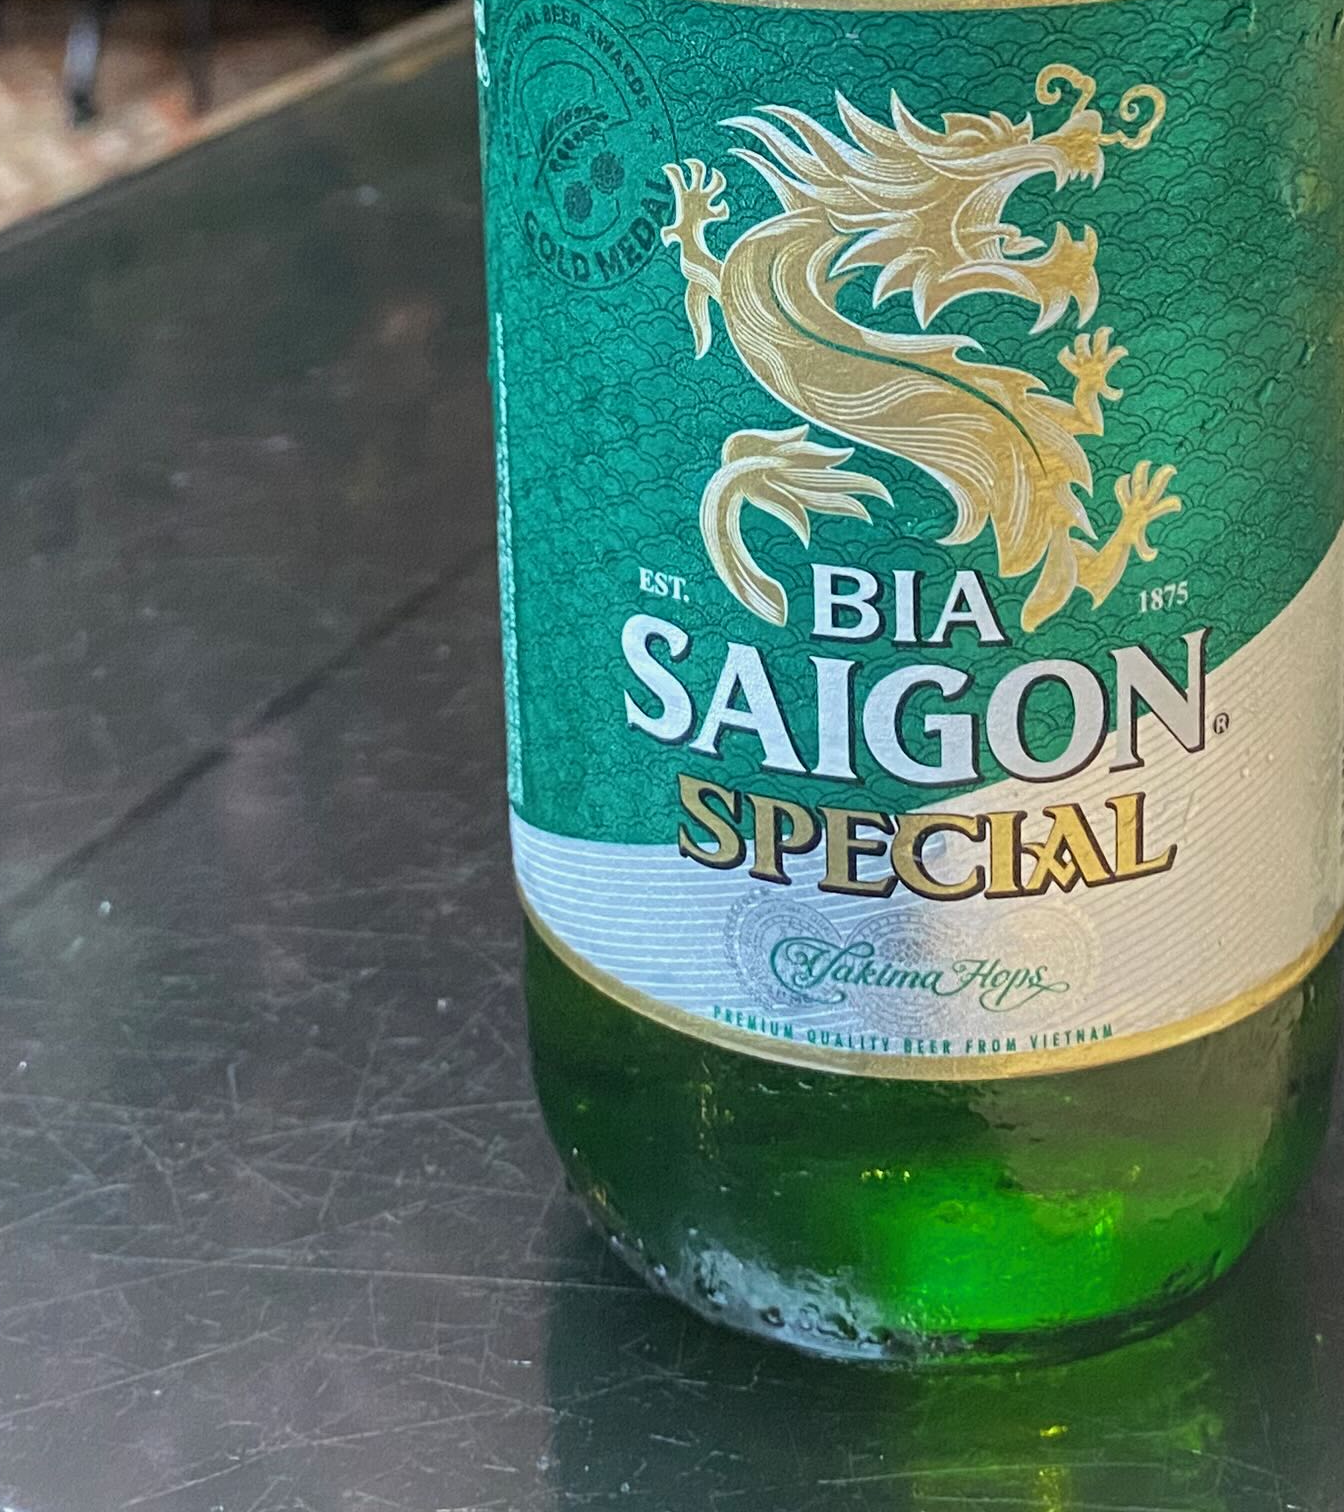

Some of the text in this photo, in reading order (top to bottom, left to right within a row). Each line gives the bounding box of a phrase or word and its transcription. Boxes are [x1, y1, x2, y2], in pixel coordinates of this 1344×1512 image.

[638, 566, 691, 602] EST.
[809, 563, 1012, 648] BIA
[1137, 581, 1190, 614] 1875
[621, 614, 1213, 787] SAIGON
[678, 773, 1179, 903] SPECIAL
[770, 936, 1071, 1013] Yakima Hops
[713, 1004, 1114, 1055] PREMIUM QUALITY BEER FROM VIETNAM
